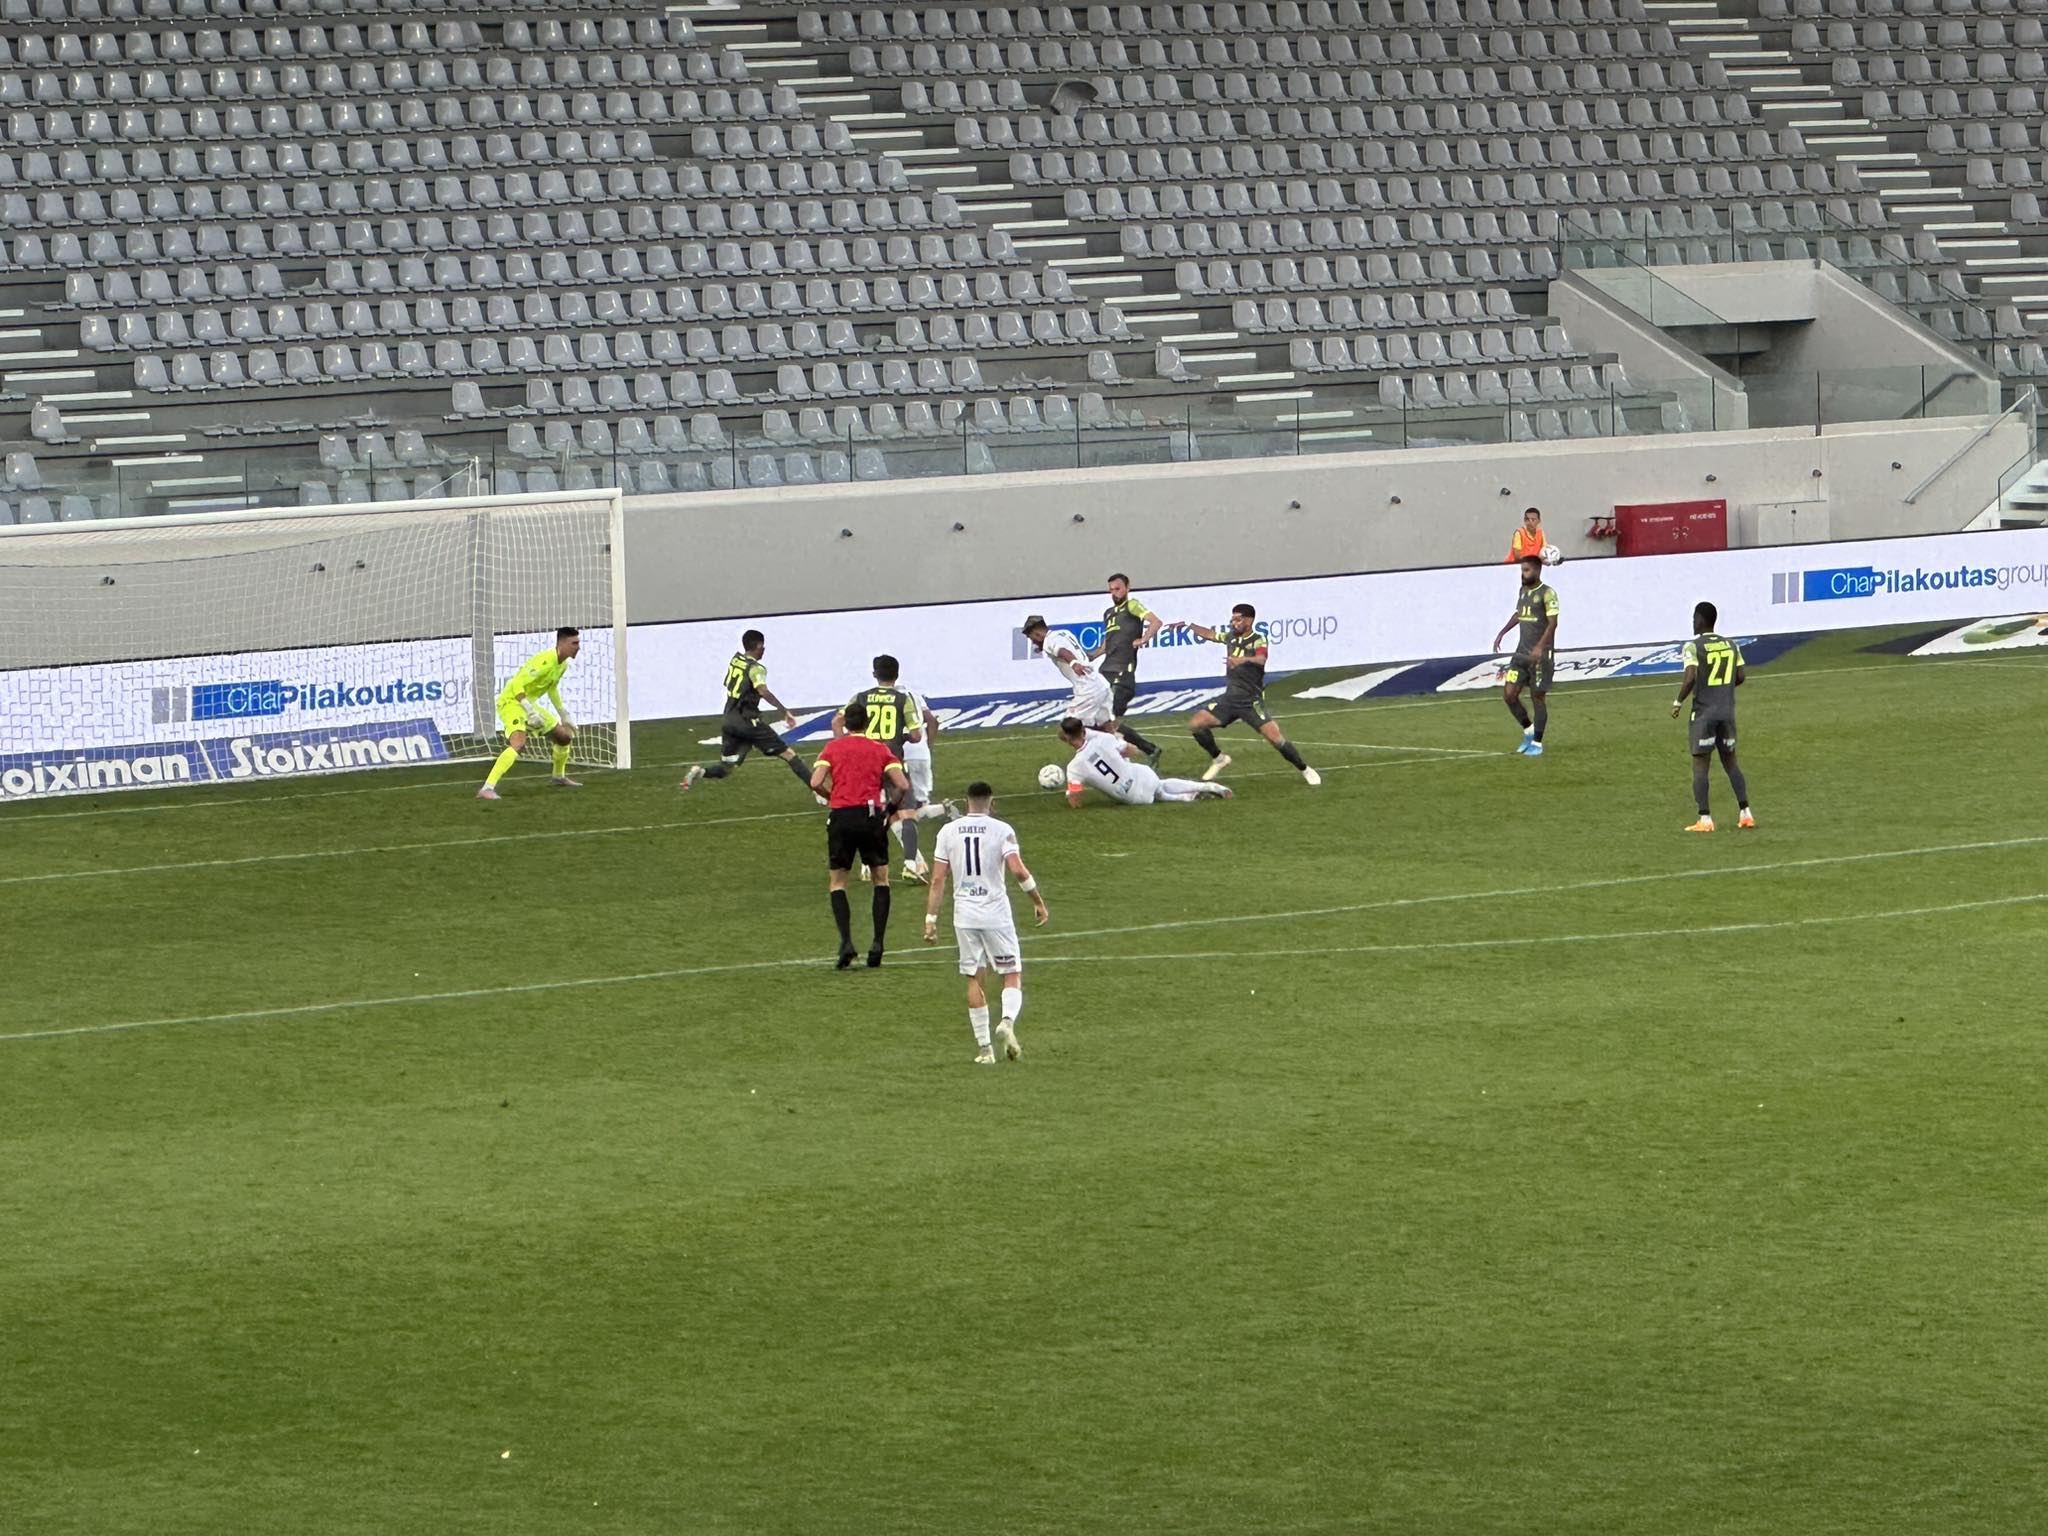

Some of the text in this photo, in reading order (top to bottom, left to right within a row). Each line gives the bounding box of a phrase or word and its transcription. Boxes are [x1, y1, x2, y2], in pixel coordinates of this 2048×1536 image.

[1706, 649, 1734, 686] 27
[865, 704, 897, 740] 28
[230, 734, 431, 777] Stoiximan
[1094, 759, 1120, 784] 9
[0, 754, 190, 796] oiximan
[964, 836, 981, 876] 11
